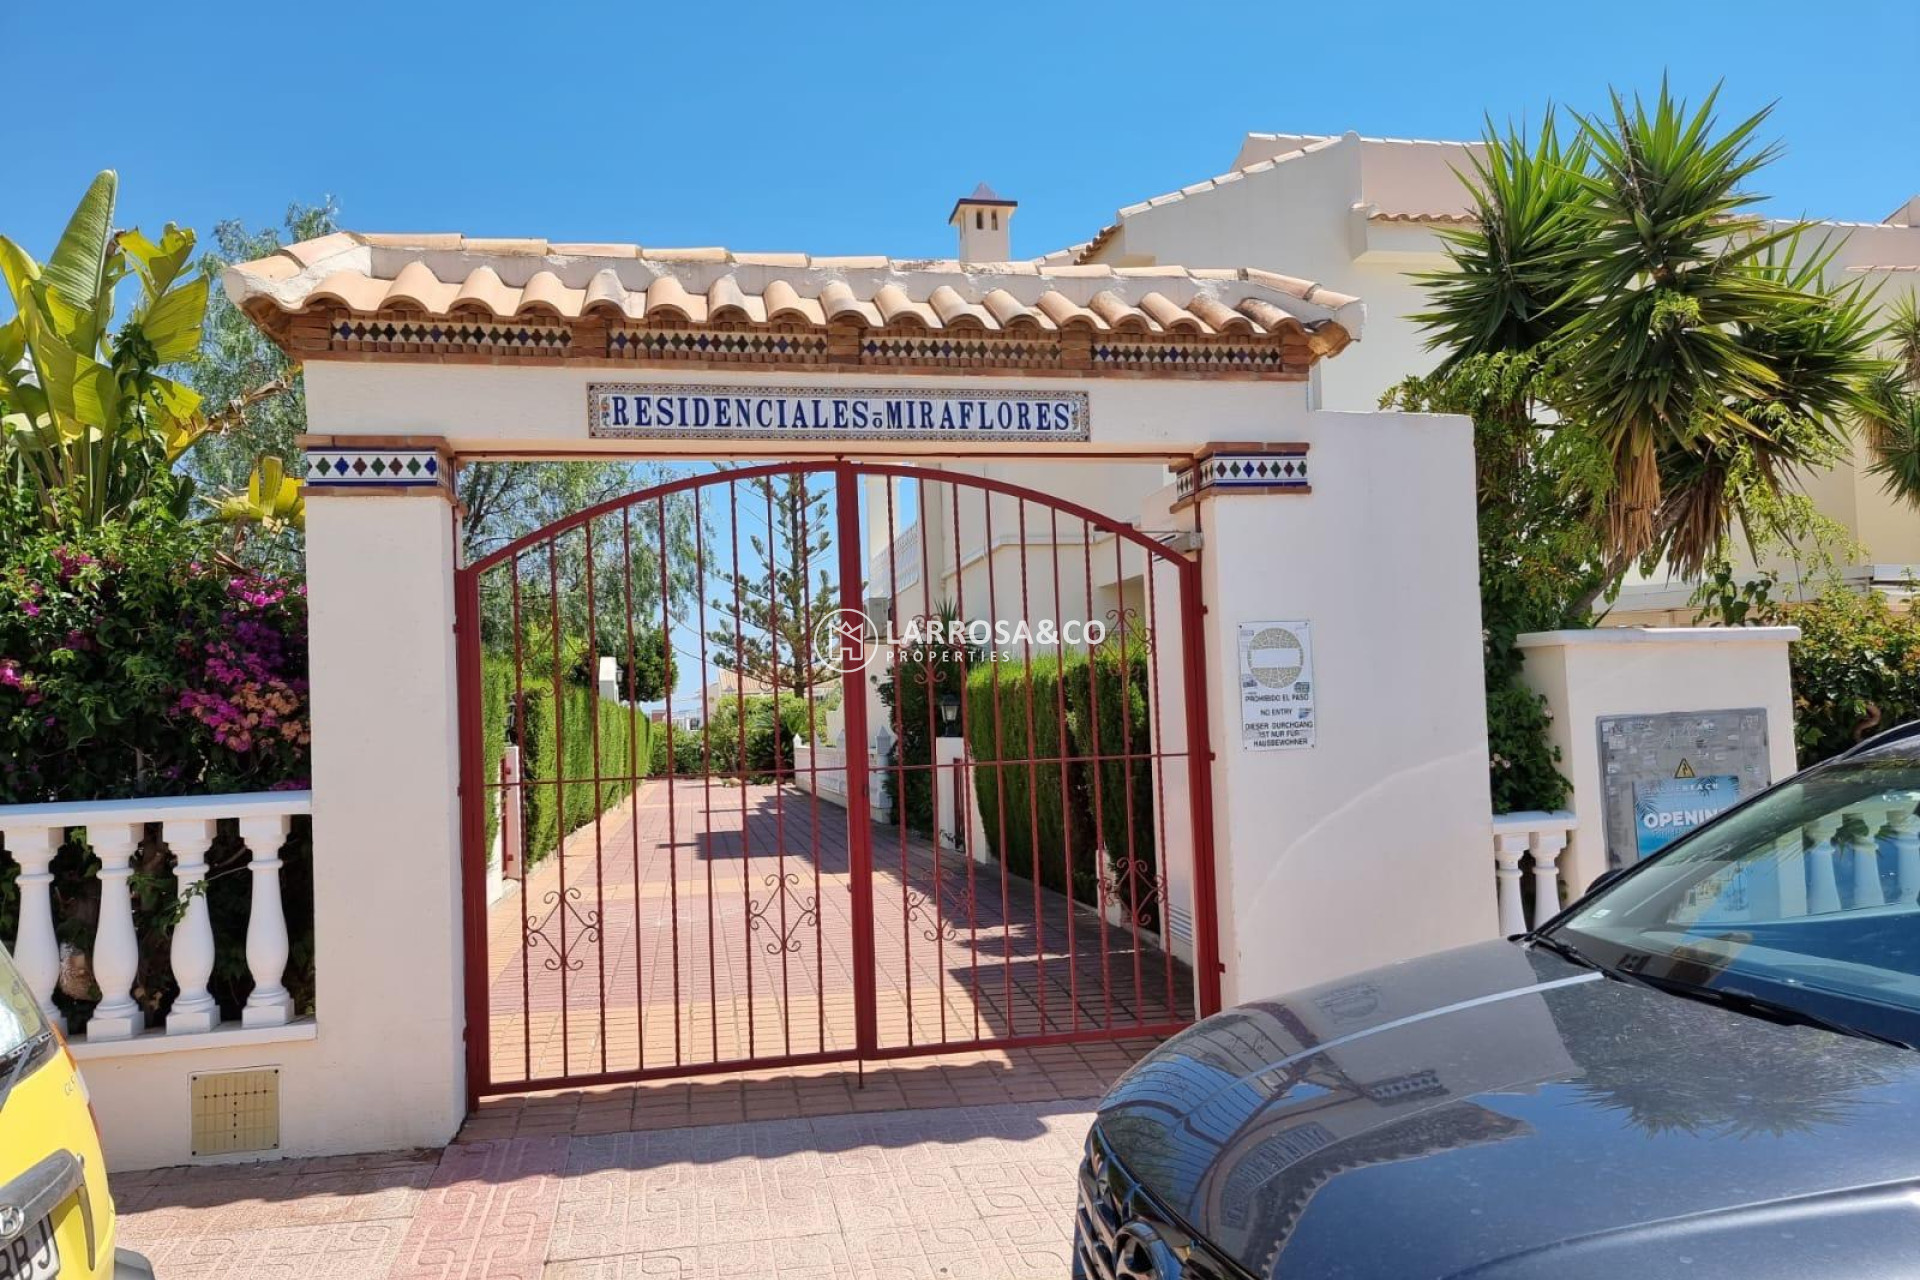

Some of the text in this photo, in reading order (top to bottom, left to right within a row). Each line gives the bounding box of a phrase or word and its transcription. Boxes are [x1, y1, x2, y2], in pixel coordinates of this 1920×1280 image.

[612, 396, 869, 428] RESIDENCIALES
[886, 400, 1070, 431] MIRAFLORES
[1245, 694, 1281, 702] PROHIBIDO
[1292, 693, 1309, 701] PASO
[1271, 708, 1292, 716] ENTRY
[1643, 807, 1728, 828] OPENIN
